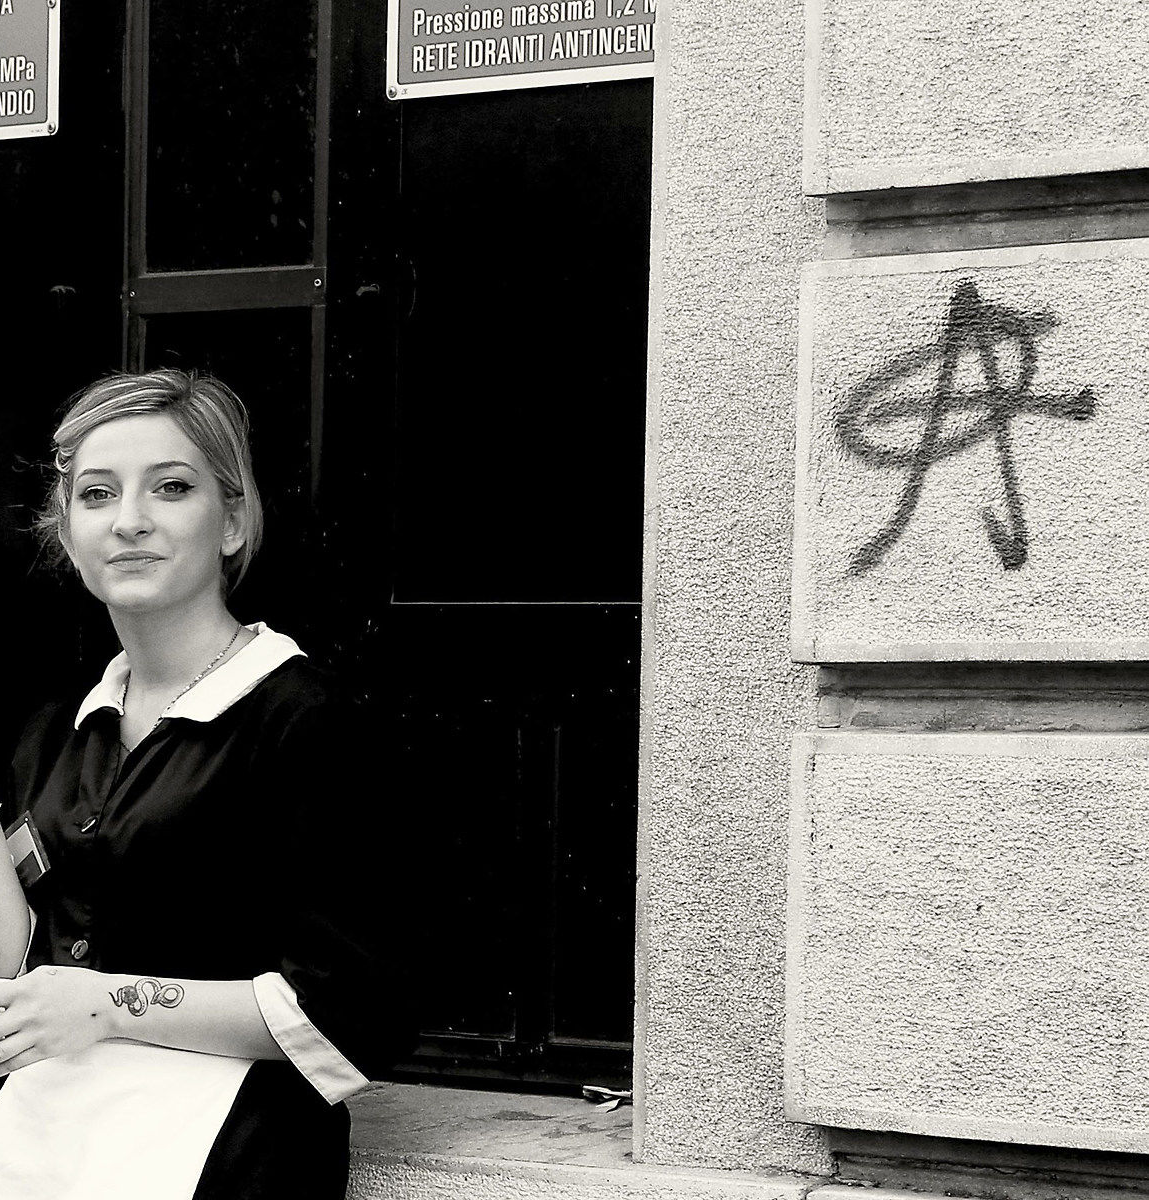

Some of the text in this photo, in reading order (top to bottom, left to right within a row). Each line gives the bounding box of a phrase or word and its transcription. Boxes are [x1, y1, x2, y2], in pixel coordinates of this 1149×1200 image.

[412, 8, 503, 37] Pressione
[511, 0, 595, 27] massima
[412, 23, 656, 73] RETE IDRANTI ANTINCEN
[0, 55, 35, 83] MPa
